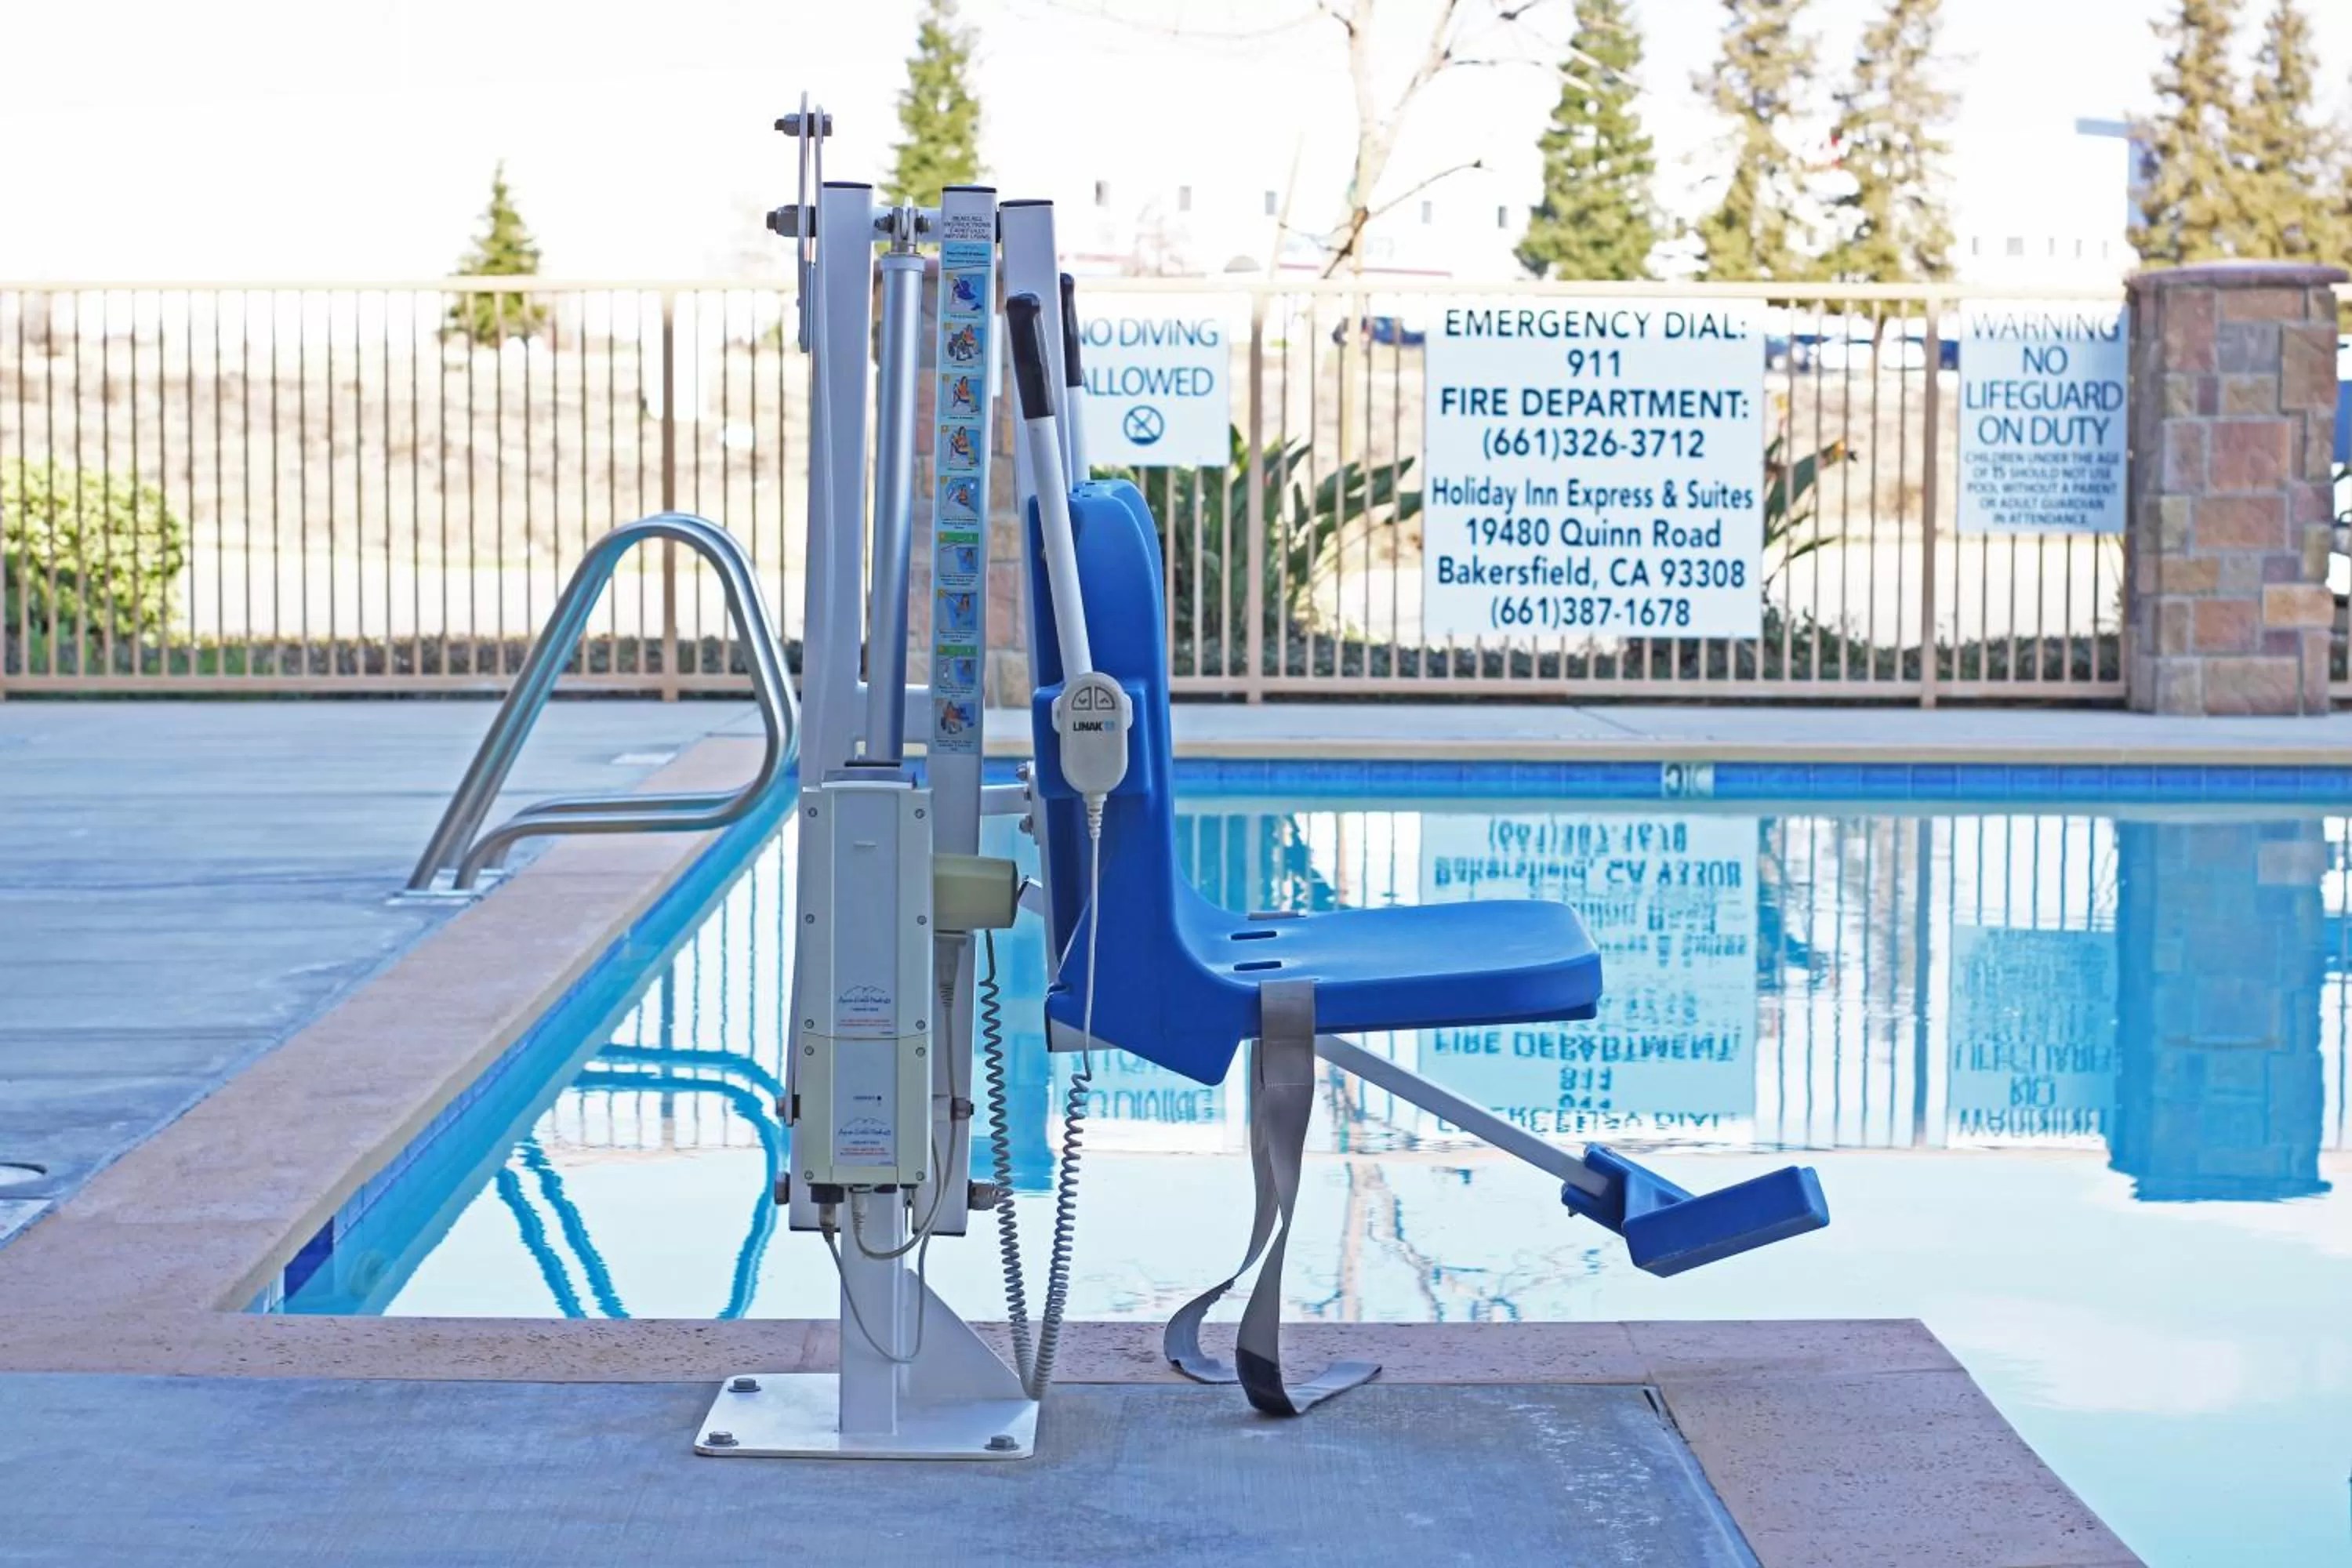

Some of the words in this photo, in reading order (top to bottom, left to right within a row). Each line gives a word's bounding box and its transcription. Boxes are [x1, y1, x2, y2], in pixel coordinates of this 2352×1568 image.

[1119, 318, 1219, 347] DIVING
[1445, 310, 1651, 339] EMERGENCY
[1664, 311, 1747, 339] DIAL:
[1971, 313, 2121, 343] WARNING
[1567, 349, 1621, 377] 911
[2022, 346, 2069, 376] NO
[1440, 387, 1508, 416] FIRE
[1521, 389, 1749, 419] DEPARTMENT:
[1965, 380, 2125, 412] LIFEGUARD
[1483, 427, 1705, 461] (661)326-3712
[1976, 416, 2024, 446] ON
[2031, 416, 2111, 447] DUTY
[1432, 477, 1518, 514] Holiday
[1525, 478, 1558, 506] Inn
[1567, 479, 1653, 515] Express
[1661, 481, 1678, 509] &
[1686, 481, 1754, 510] Suites
[1466, 517, 1550, 546] 19480
[1559, 518, 1642, 548] Quinn
[1652, 518, 1722, 548] Road
[1437, 555, 1599, 590] Bakersfield,
[1609, 557, 1650, 588] CA
[1660, 558, 1746, 588] 93308
[1490, 597, 1691, 630] (661)387-1678
[1073, 720, 1103, 731] LINAK
